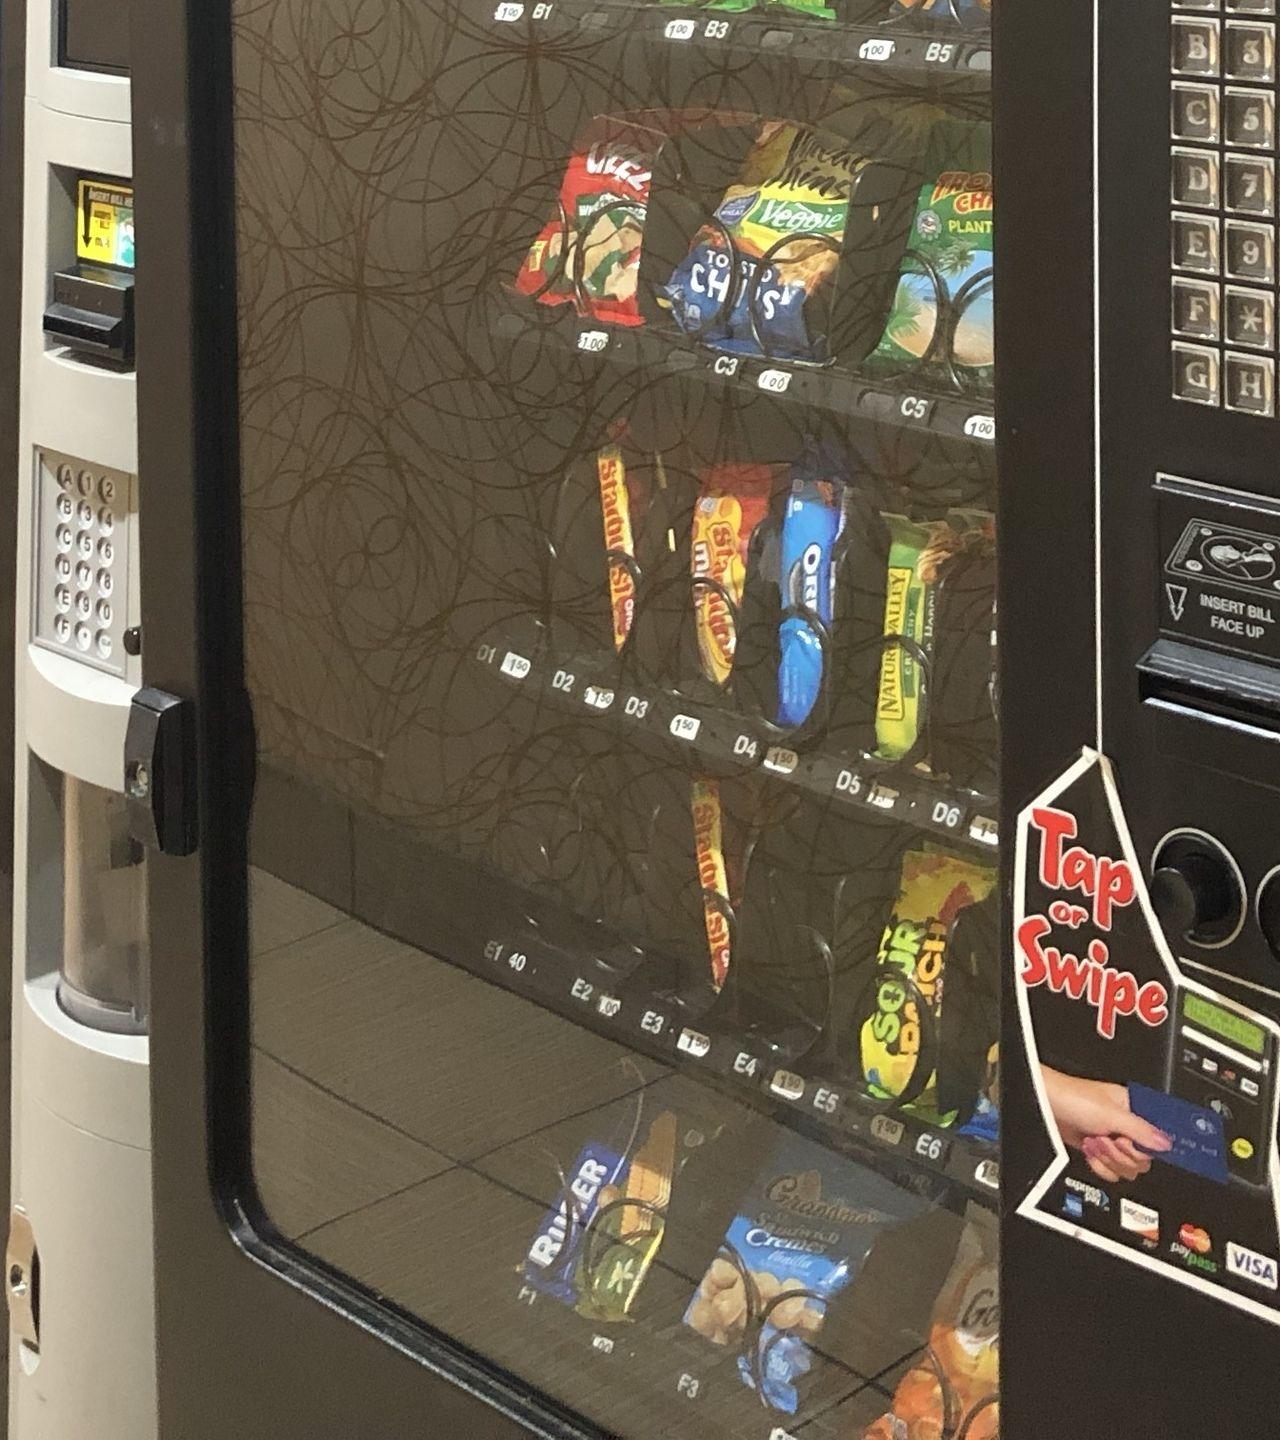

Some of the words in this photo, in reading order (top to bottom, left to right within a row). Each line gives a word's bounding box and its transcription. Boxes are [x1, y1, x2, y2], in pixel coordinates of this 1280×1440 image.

[532, 3, 553, 21] B1
[704, 20, 729, 39] B3
[925, 42, 953, 63] B5
[1187, 34, 1207, 59] B
[1243, 40, 1260, 64] 3
[1186, 100, 1207, 125] C
[1243, 107, 1259, 131] 5
[1188, 165, 1208, 191] D
[1242, 172, 1258, 198] 7
[759, 197, 845, 232] Veggie
[948, 219, 994, 235] PLANT
[1187, 231, 1207, 258] E
[1242, 240, 1259, 264] 9
[1189, 296, 1209, 321] F
[714, 356, 738, 376] C3
[1186, 362, 1208, 388] G
[1239, 370, 1262, 399] H
[901, 396, 928, 418] C5
[1200, 593, 1247, 617] INSERT
[1248, 602, 1276, 624] BILL
[1210, 616, 1243, 637] FACE
[1245, 622, 1265, 638] UP
[553, 671, 575, 693] D2
[625, 696, 649, 718] D3
[734, 734, 758, 758] D4
[835, 769, 861, 795] D5
[932, 802, 960, 828] D6
[1032, 806, 1137, 931] Tap
[509, 952, 527, 972] 40
[571, 977, 594, 1001] E2
[1017, 914, 1168, 1039] Swipe
[641, 1010, 665, 1034] E3
[734, 1051, 758, 1077] E4
[813, 1087, 840, 1113] E5
[915, 1132, 943, 1159] E6
[1233, 1250, 1276, 1284] VISA
[677, 1372, 700, 1399] F3
